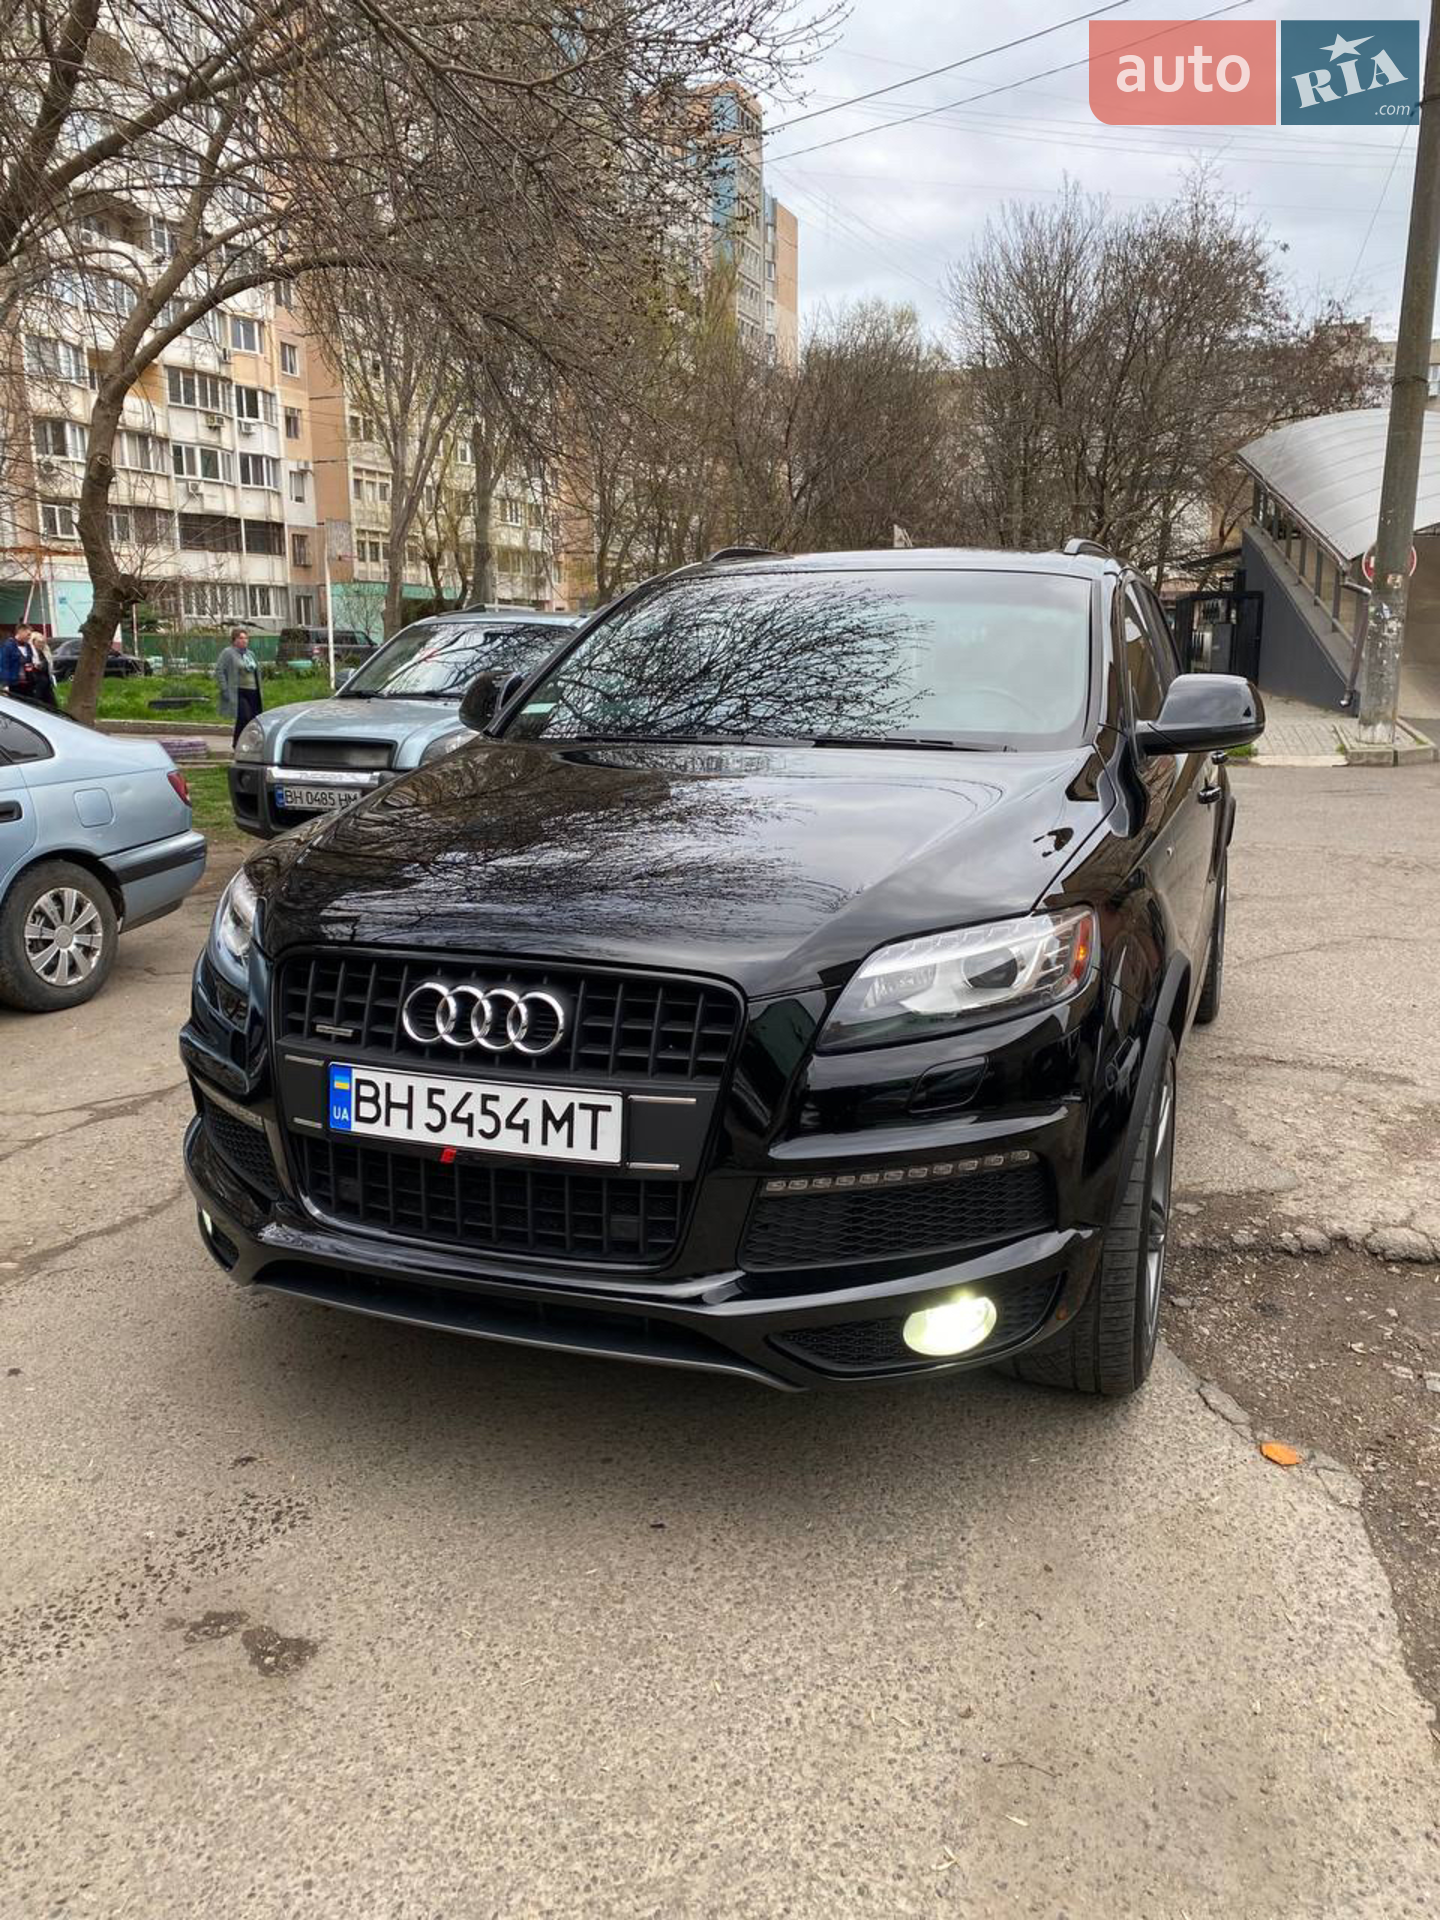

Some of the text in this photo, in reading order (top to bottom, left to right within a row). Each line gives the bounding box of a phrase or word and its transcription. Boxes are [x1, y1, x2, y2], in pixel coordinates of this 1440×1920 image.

[285, 790, 304, 805] BH
[306, 791, 335, 806] 0485
[333, 1106, 349, 1122] UA
[354, 1078, 612, 1150] BH 5454 MT
